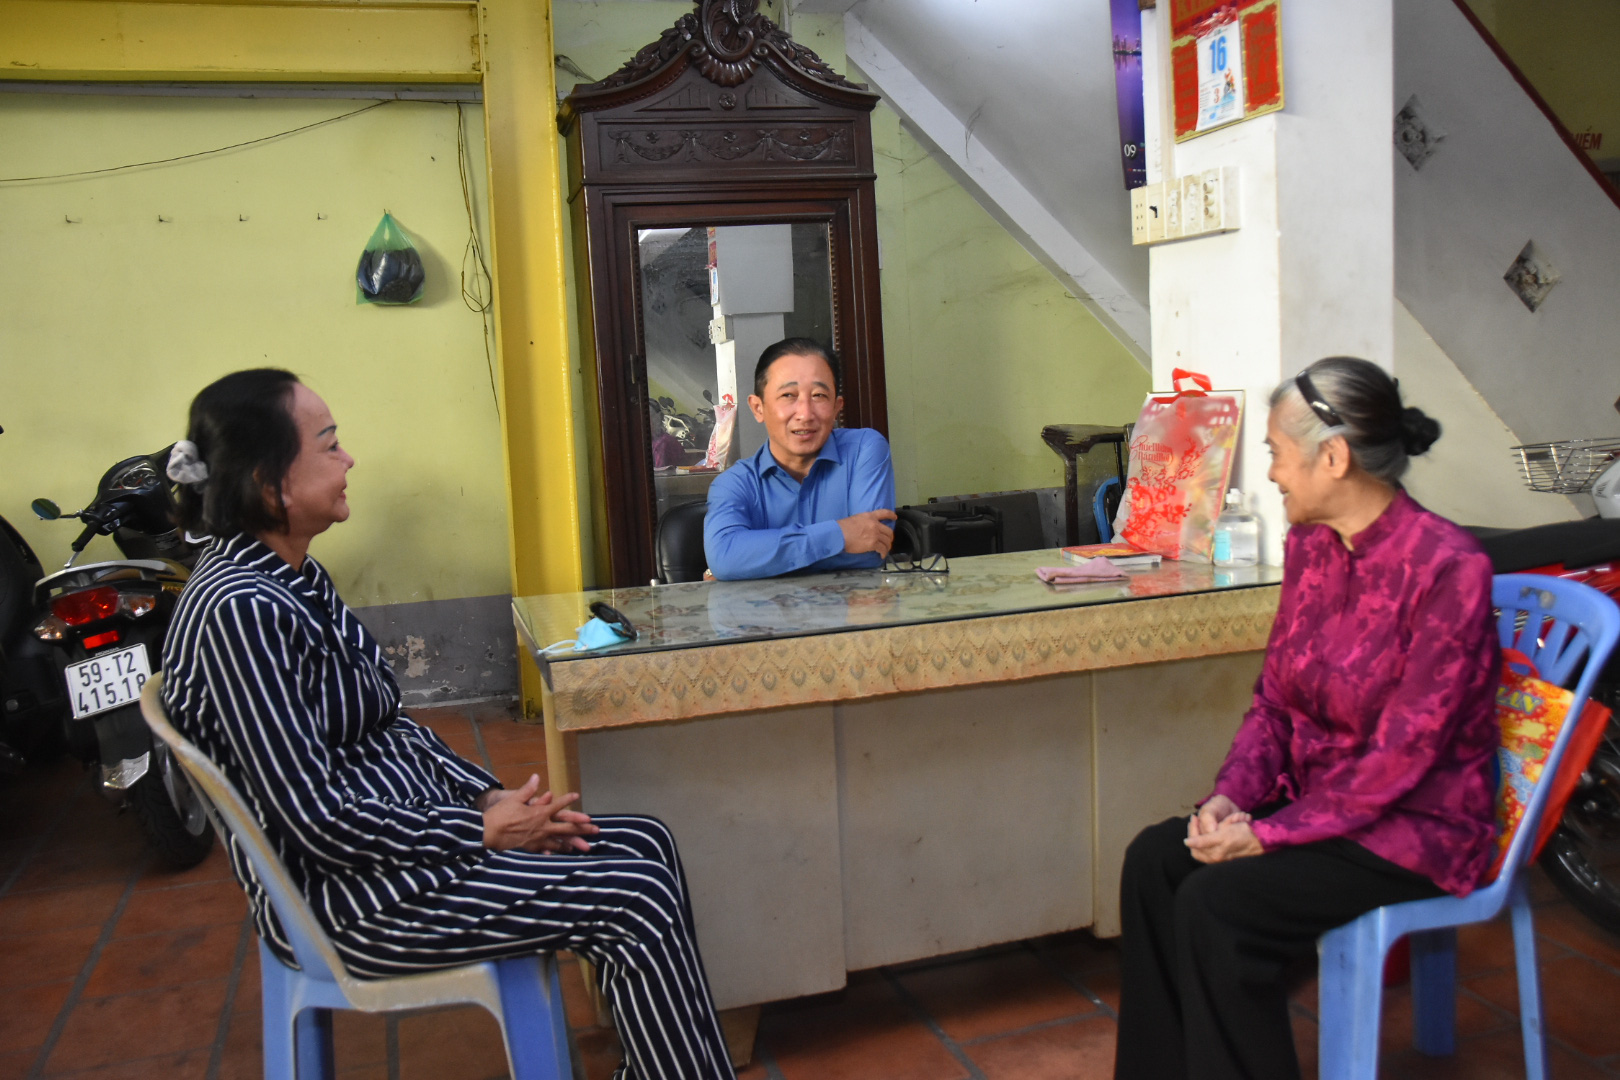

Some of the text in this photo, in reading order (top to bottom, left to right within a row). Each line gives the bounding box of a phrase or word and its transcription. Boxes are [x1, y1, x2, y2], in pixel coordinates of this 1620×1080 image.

[1209, 36, 1227, 74] 16
[1124, 143, 1137, 157] 09
[78, 651, 137, 687] 59-T2
